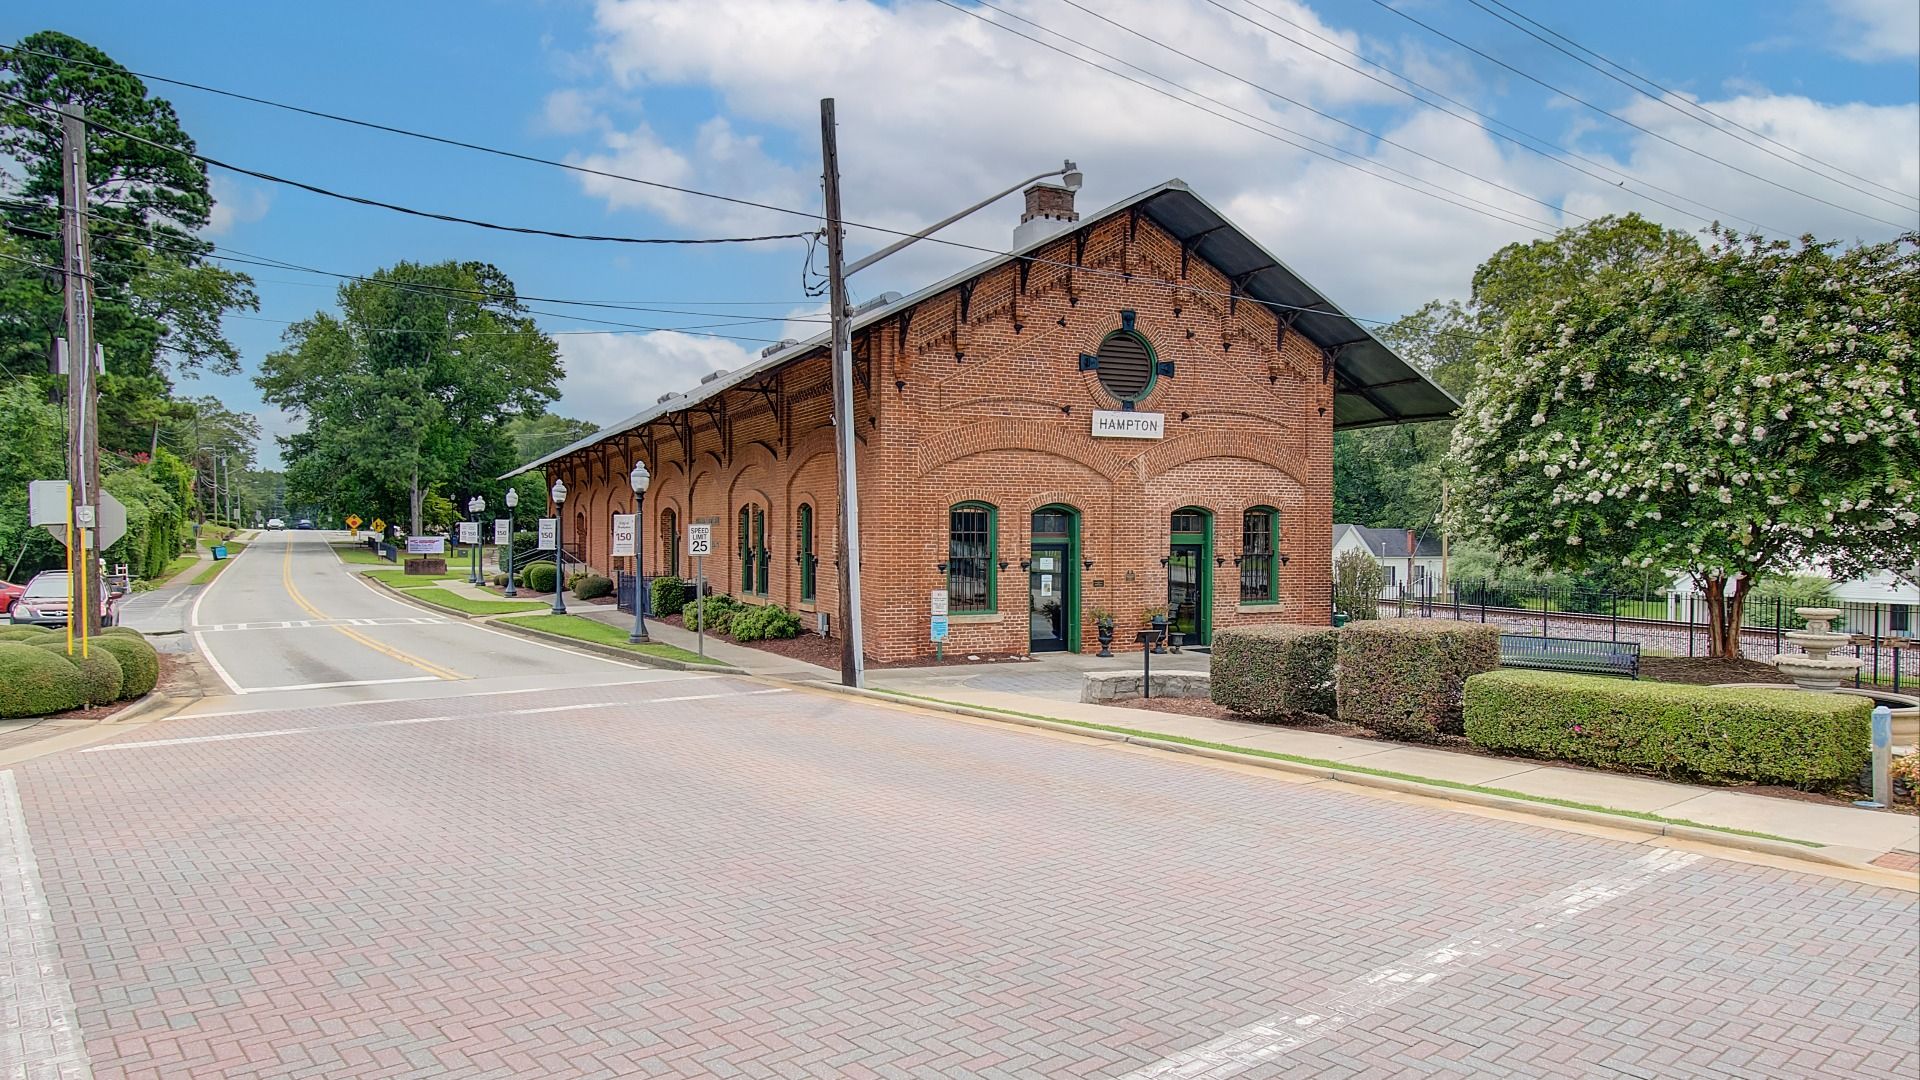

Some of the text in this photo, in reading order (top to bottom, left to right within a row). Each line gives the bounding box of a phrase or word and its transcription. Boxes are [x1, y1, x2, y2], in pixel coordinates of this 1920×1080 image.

[1099, 418, 1158, 431] HAMPTON
[615, 532, 632, 541] 150
[692, 541, 708, 552] 25
